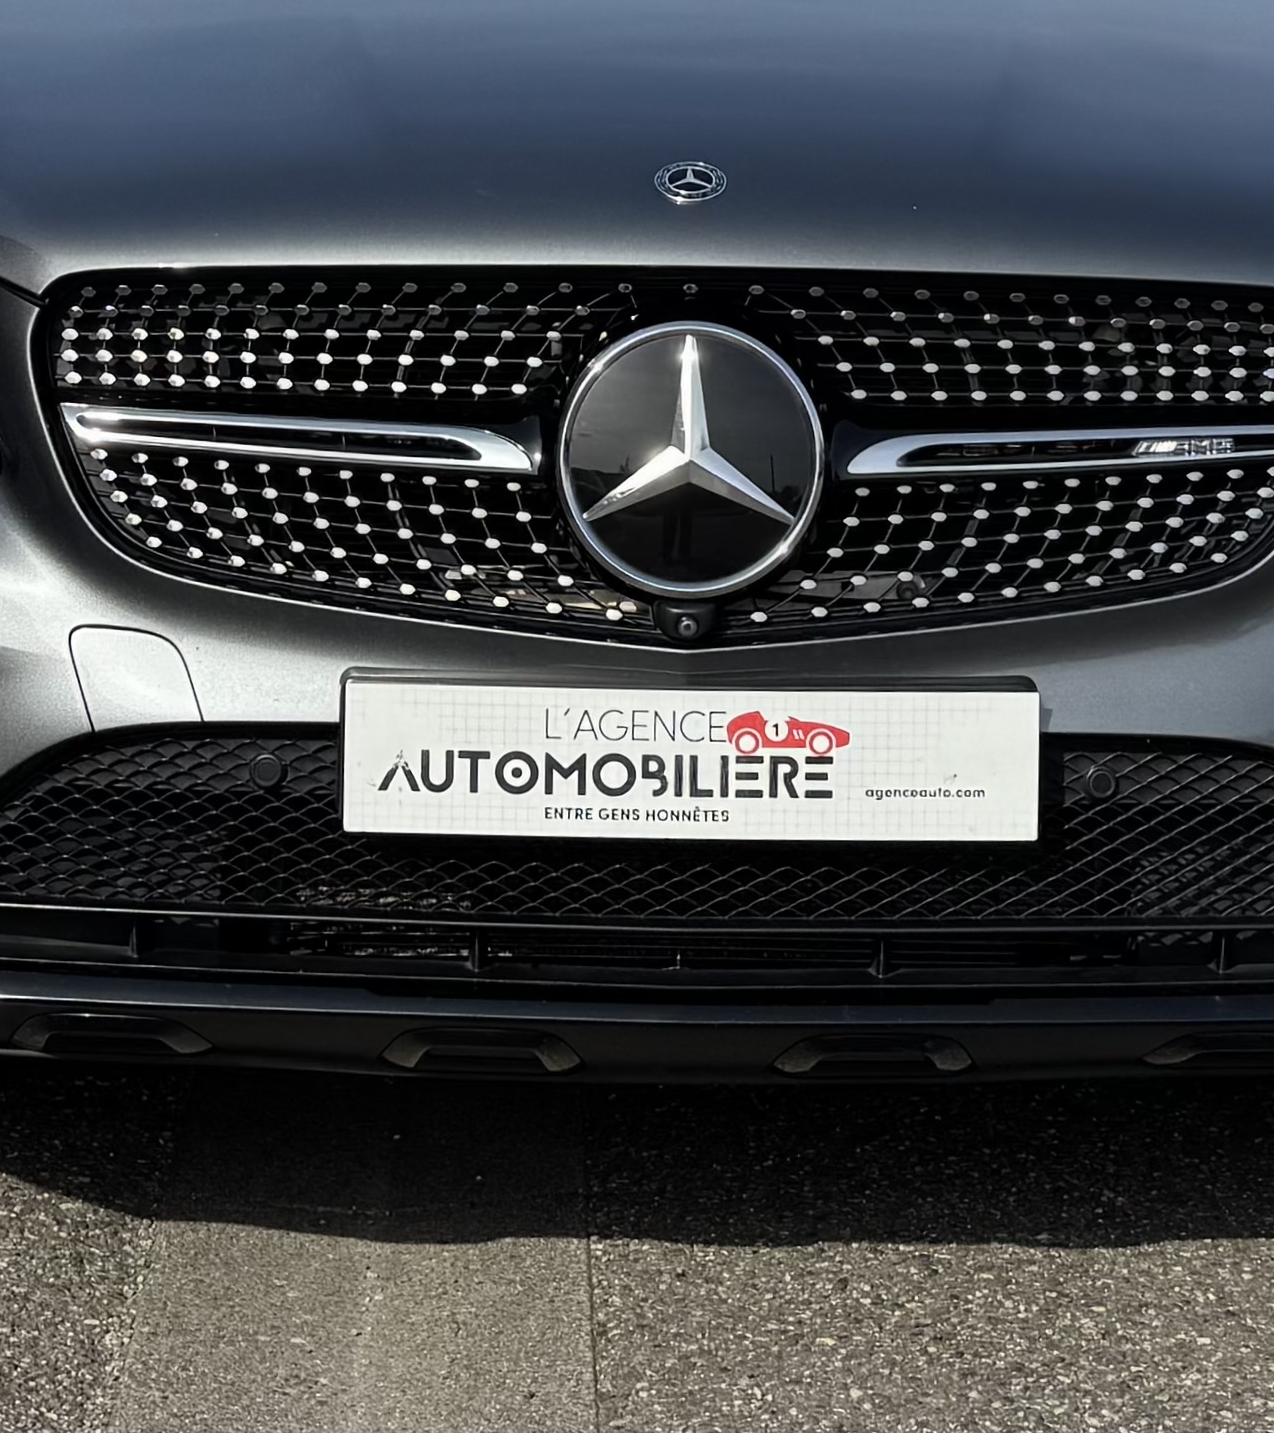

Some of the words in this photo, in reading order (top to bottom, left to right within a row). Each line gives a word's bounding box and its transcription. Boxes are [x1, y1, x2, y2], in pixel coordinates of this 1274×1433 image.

[544, 707, 727, 743] L'AGENCE
[772, 722, 779, 737] 1
[864, 785, 986, 800] agenceauto.com
[544, 807, 594, 821] ENTRE
[598, 808, 641, 822] GENS
[645, 805, 730, 824] HONNÊTES
